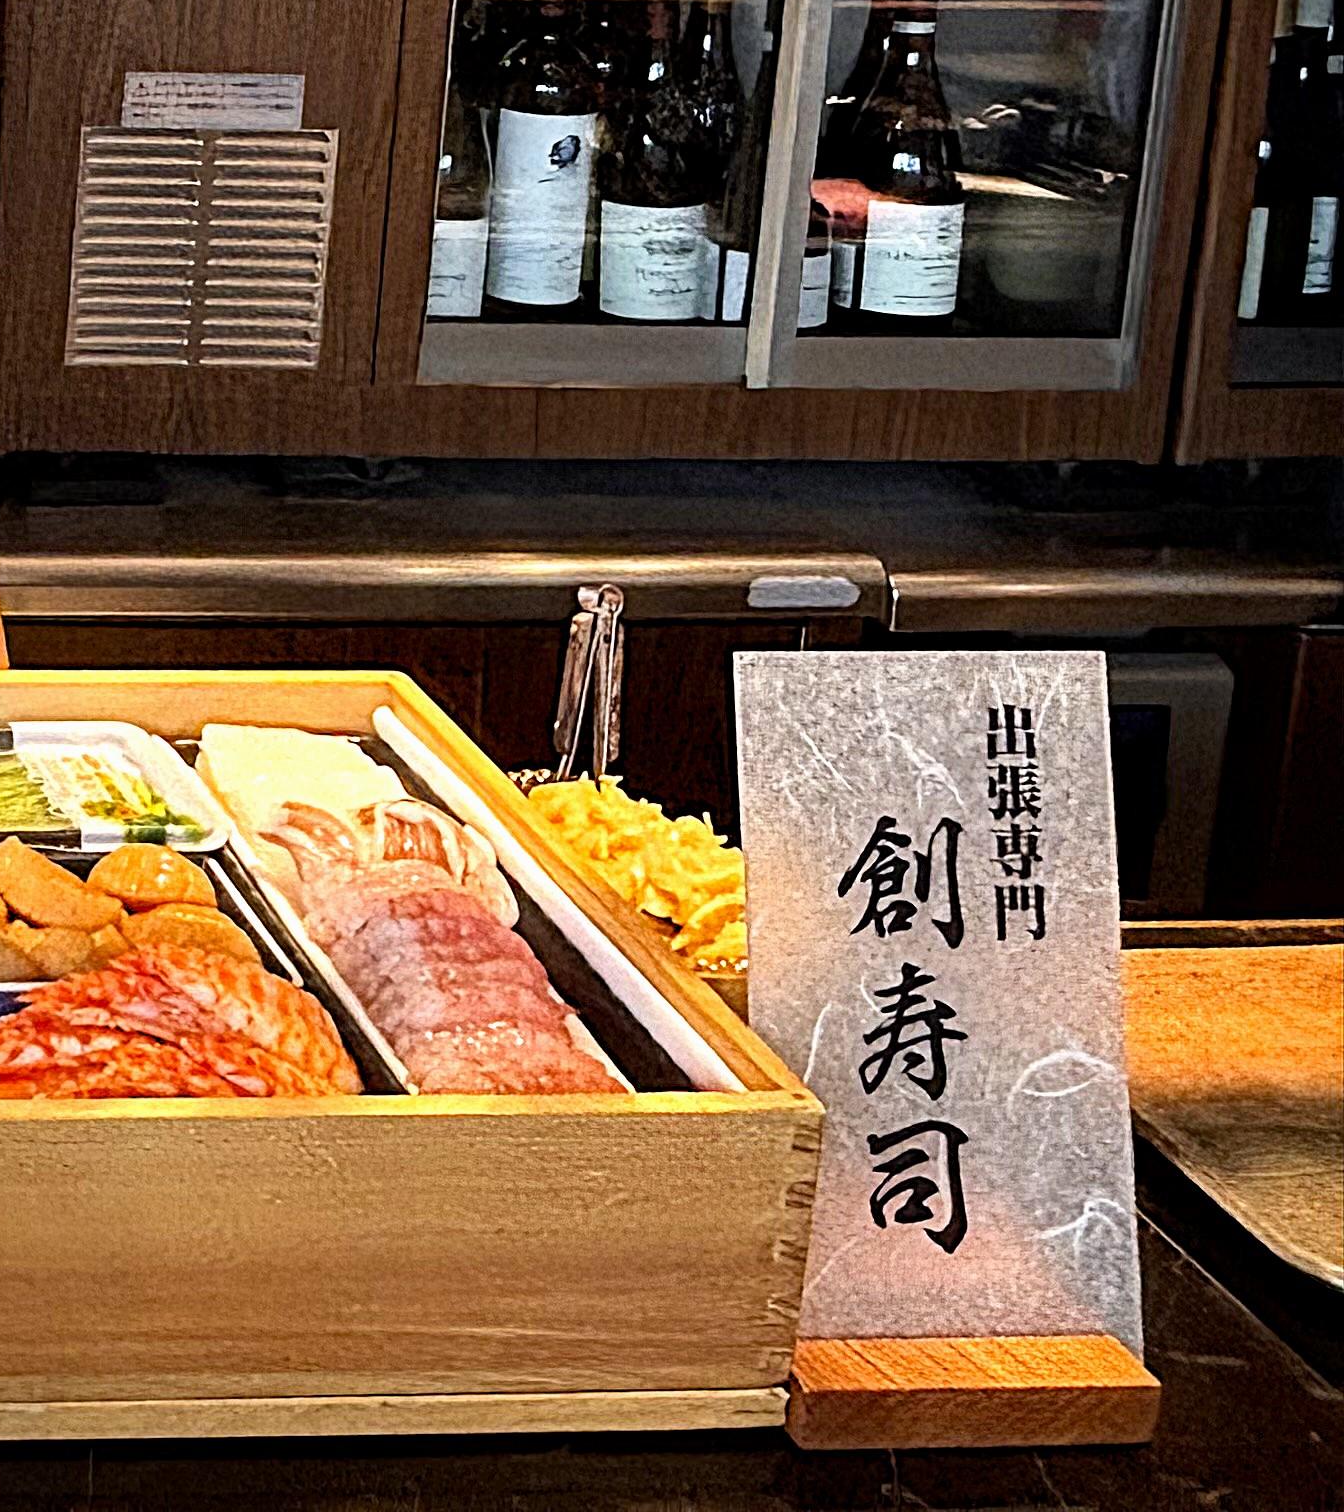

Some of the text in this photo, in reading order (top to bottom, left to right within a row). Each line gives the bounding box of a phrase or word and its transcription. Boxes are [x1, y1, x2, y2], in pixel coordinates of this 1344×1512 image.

[985, 702, 1046, 943] 出張専門
[836, 815, 969, 1255] 創寿司
